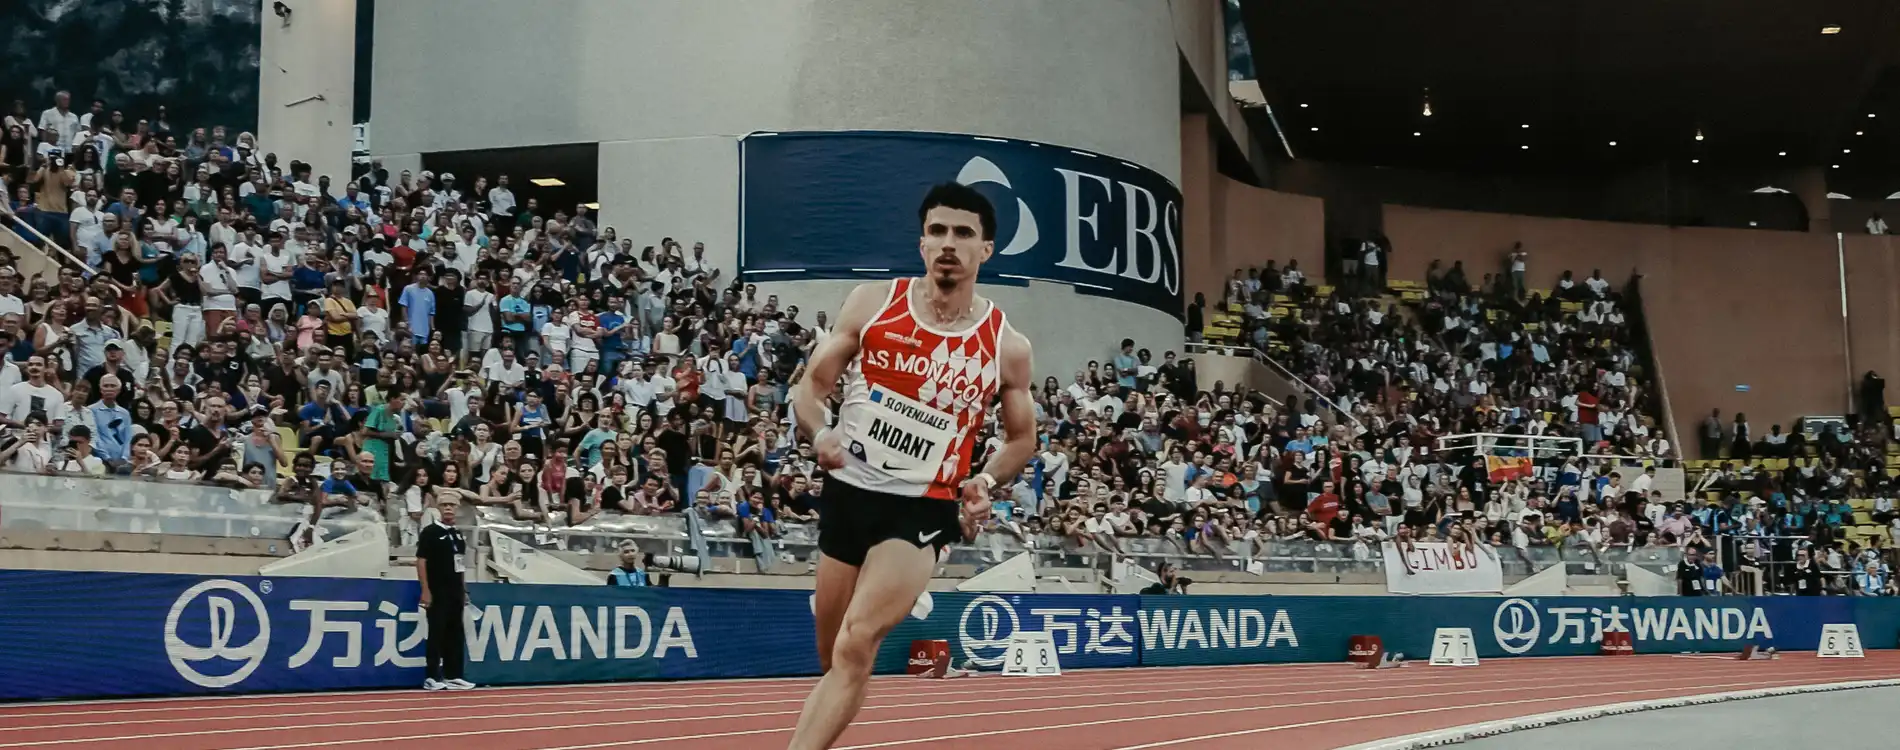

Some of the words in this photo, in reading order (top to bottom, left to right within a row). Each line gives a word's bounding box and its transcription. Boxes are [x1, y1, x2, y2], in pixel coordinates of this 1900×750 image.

[1053, 167, 1180, 296] EBS
[867, 350, 889, 369] AS
[894, 352, 979, 402] MONACO
[867, 417, 936, 461] ANDANT
[464, 605, 698, 661] WANDA
[1137, 609, 1299, 650] WANDA
[1629, 607, 1774, 640] WANDA
[1015, 648, 1023, 665] 8
[1040, 648, 1048, 665] 8
[1442, 641, 1450, 657] 7
[1827, 636, 1836, 649] 6
